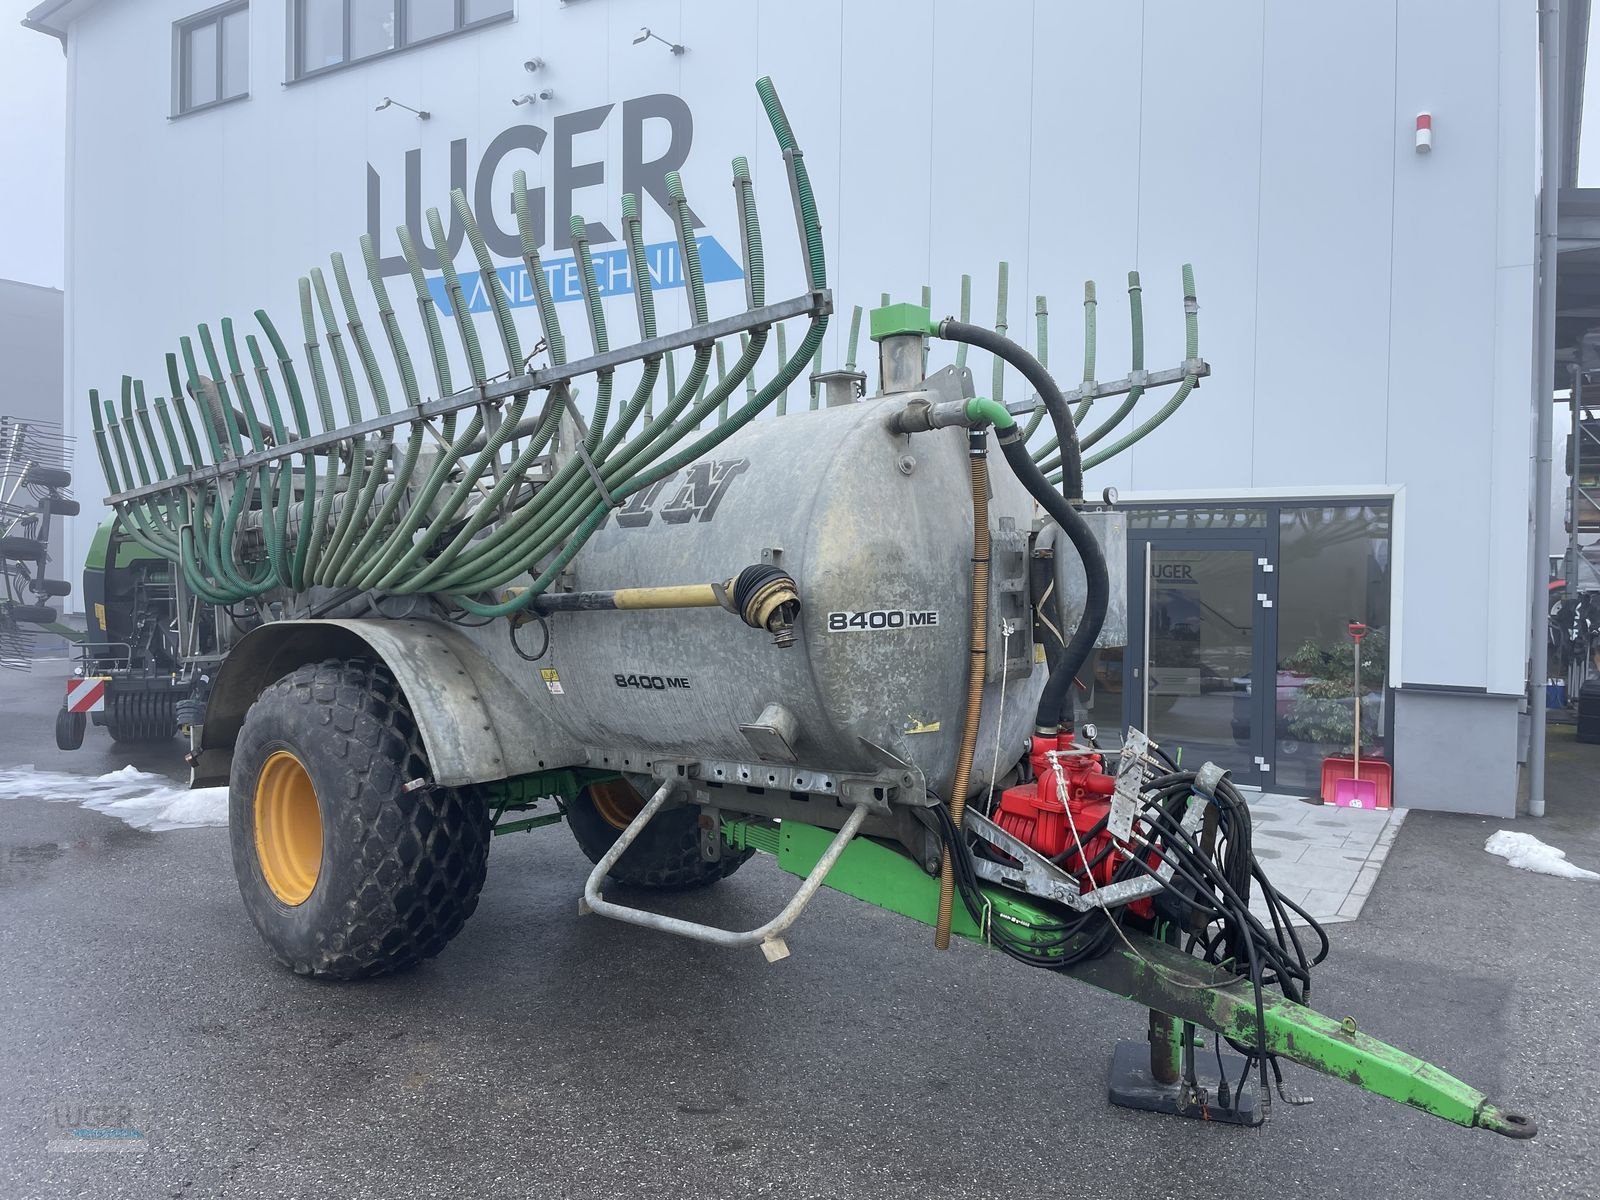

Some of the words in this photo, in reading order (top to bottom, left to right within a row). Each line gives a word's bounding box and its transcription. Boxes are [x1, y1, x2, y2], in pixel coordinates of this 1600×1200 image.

[366, 93, 706, 280] LUGER
[1151, 564, 1192, 579] UGER
[829, 611, 904, 630] 8400
[909, 612, 937, 626] ME
[614, 674, 665, 690] 8400
[666, 677, 690, 689] ME
